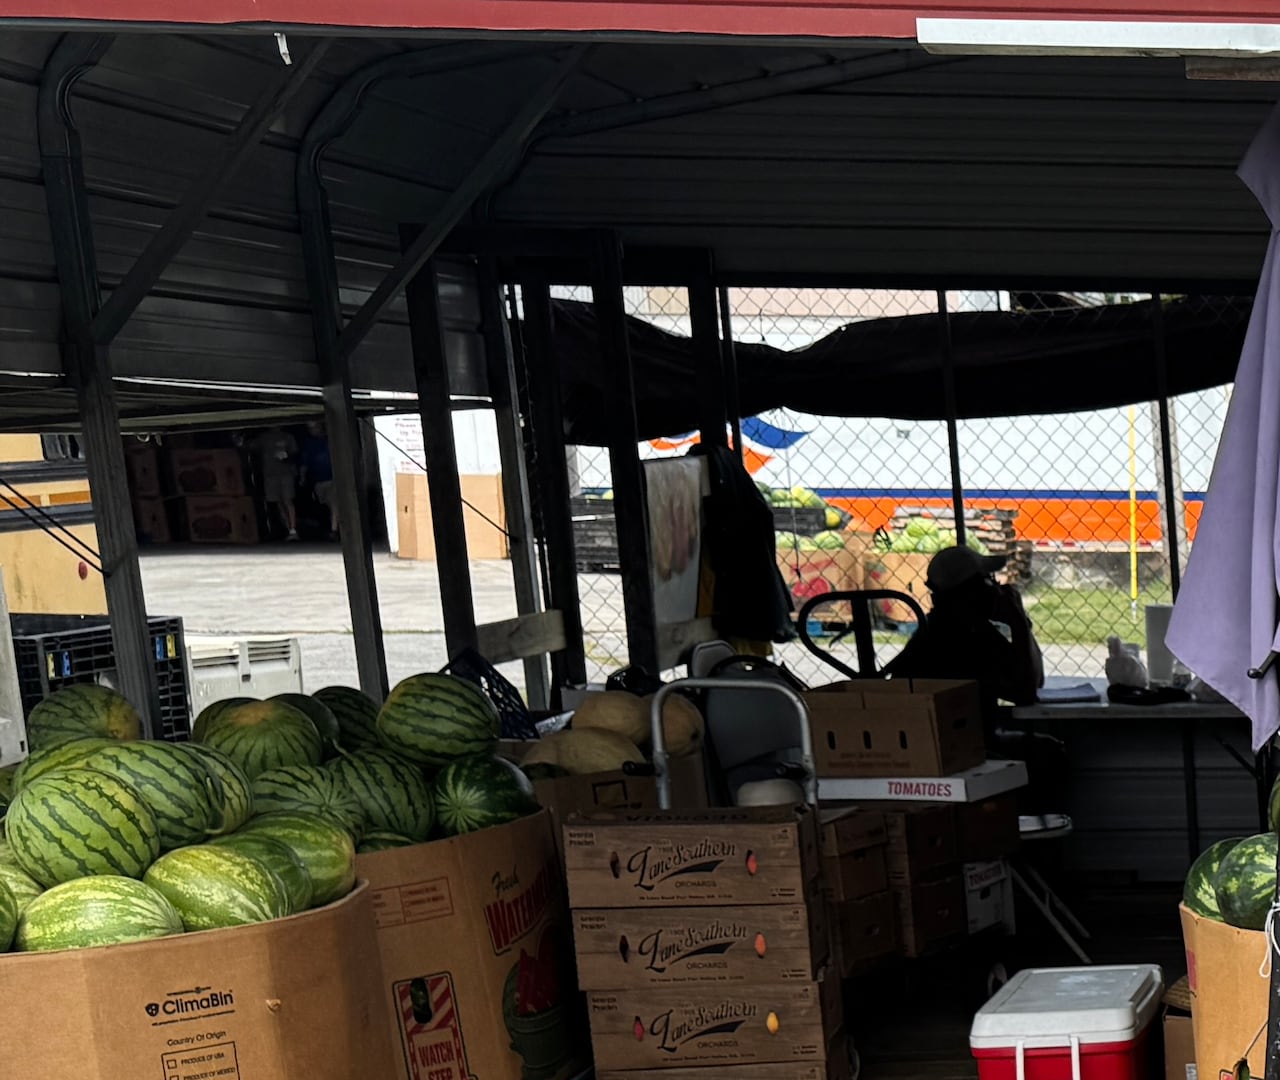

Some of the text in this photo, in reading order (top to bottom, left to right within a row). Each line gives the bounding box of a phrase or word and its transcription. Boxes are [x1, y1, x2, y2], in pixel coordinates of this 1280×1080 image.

[888, 781, 952, 797] TOMATOES
[627, 838, 737, 891] Lane Southern
[638, 919, 749, 973] Lane Southern
[162, 990, 233, 1015] ClimaBin
[650, 1000, 757, 1053] Lane Southern
[418, 1040, 455, 1068] WATCH
